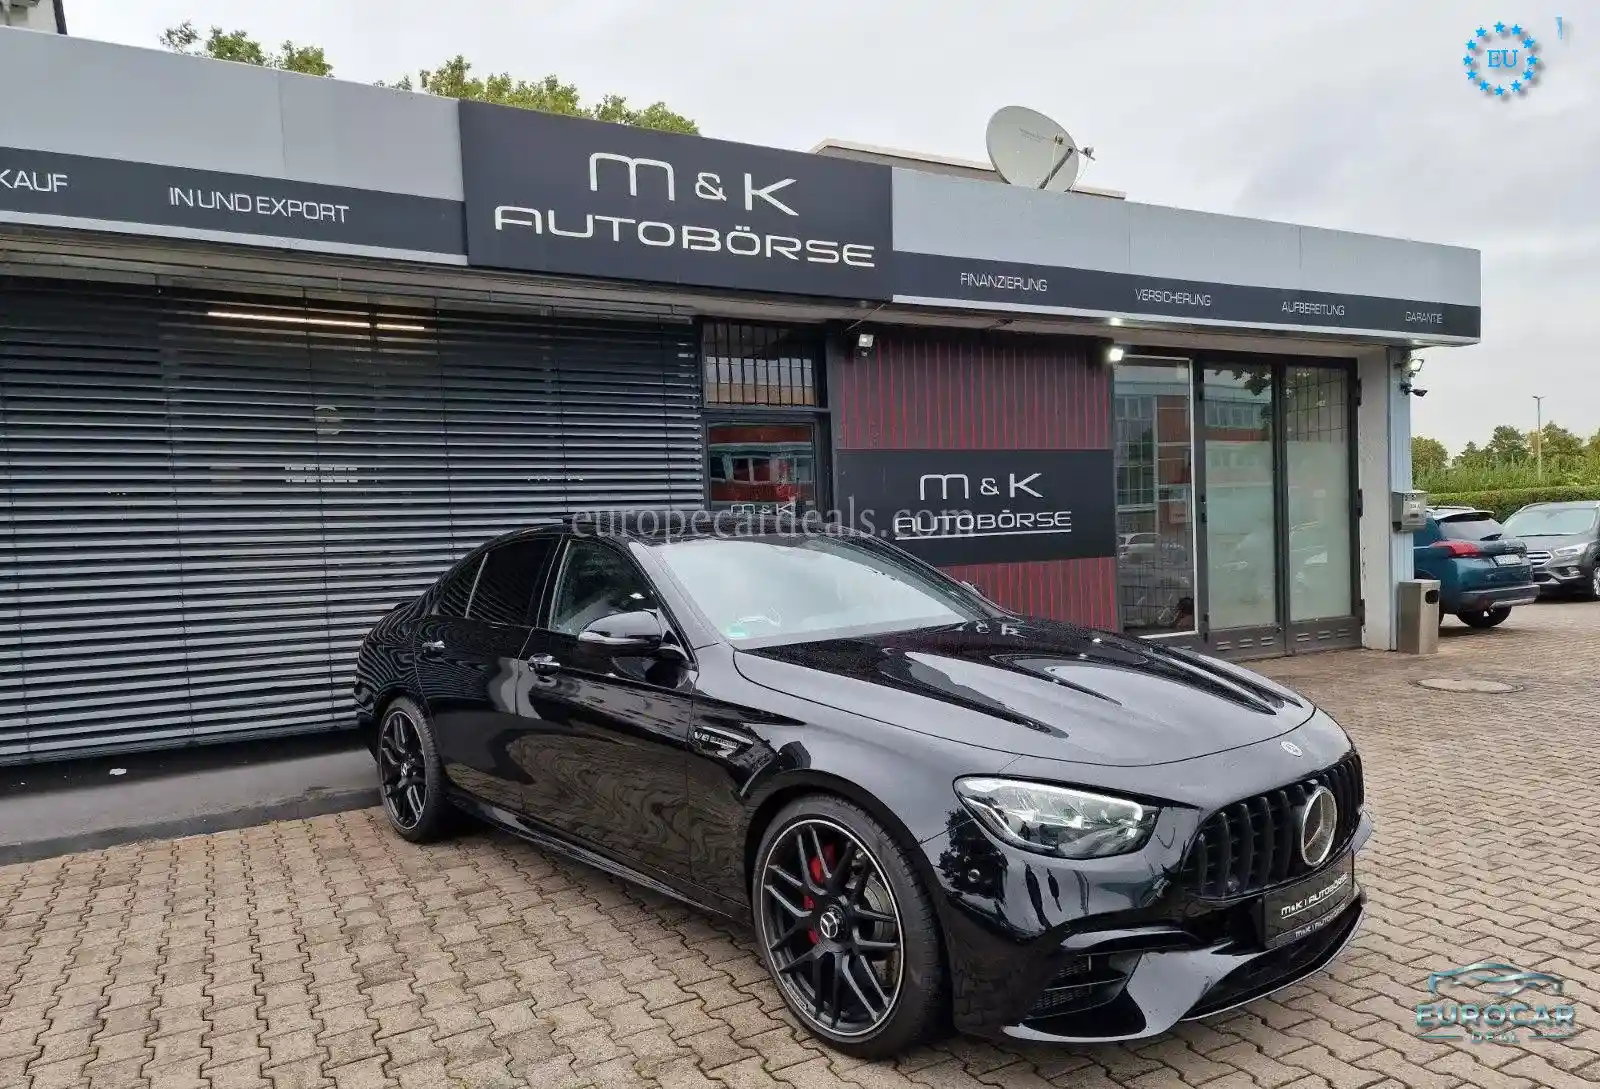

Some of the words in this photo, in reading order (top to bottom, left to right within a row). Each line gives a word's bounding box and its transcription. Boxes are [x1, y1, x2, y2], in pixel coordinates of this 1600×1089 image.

[0, 168, 68, 193] KAUF
[169, 186, 193, 208] IN
[197, 189, 252, 213] UND
[256, 195, 350, 224] EXPORT
[695, 172, 727, 202] &
[743, 172, 800, 217] K
[494, 204, 876, 269] AUTOBÖRSE
[960, 271, 1048, 292] FINANZIERUNG
[1134, 287, 1212, 307] VERSICHERUNG
[1281, 300, 1345, 317] AUFBEREITUNG
[980, 477, 1000, 496] &
[1009, 472, 1044, 499] K
